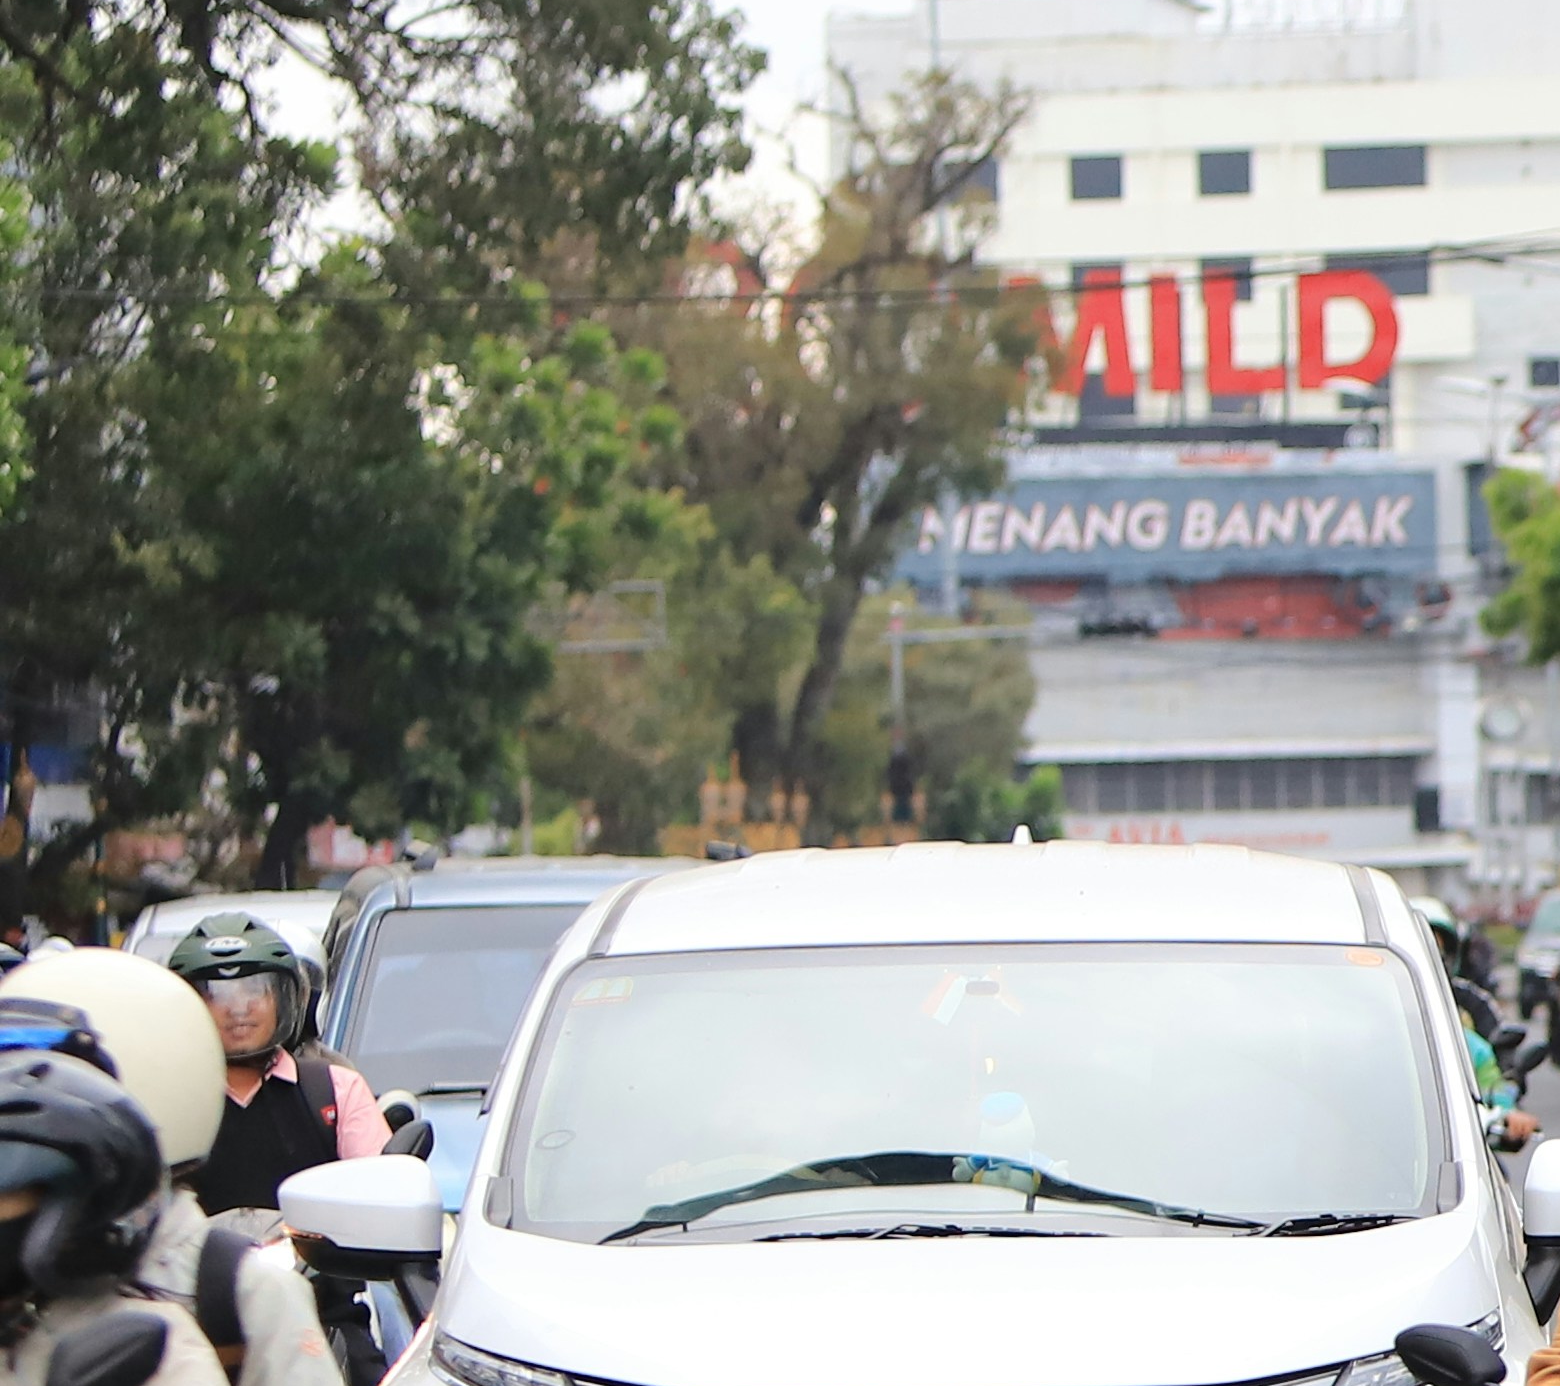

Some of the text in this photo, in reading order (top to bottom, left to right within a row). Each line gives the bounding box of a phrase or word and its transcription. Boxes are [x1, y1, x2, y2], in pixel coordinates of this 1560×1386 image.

[1004, 269, 1398, 398] MILD
[918, 495, 1414, 555] MENANG BANYAK
